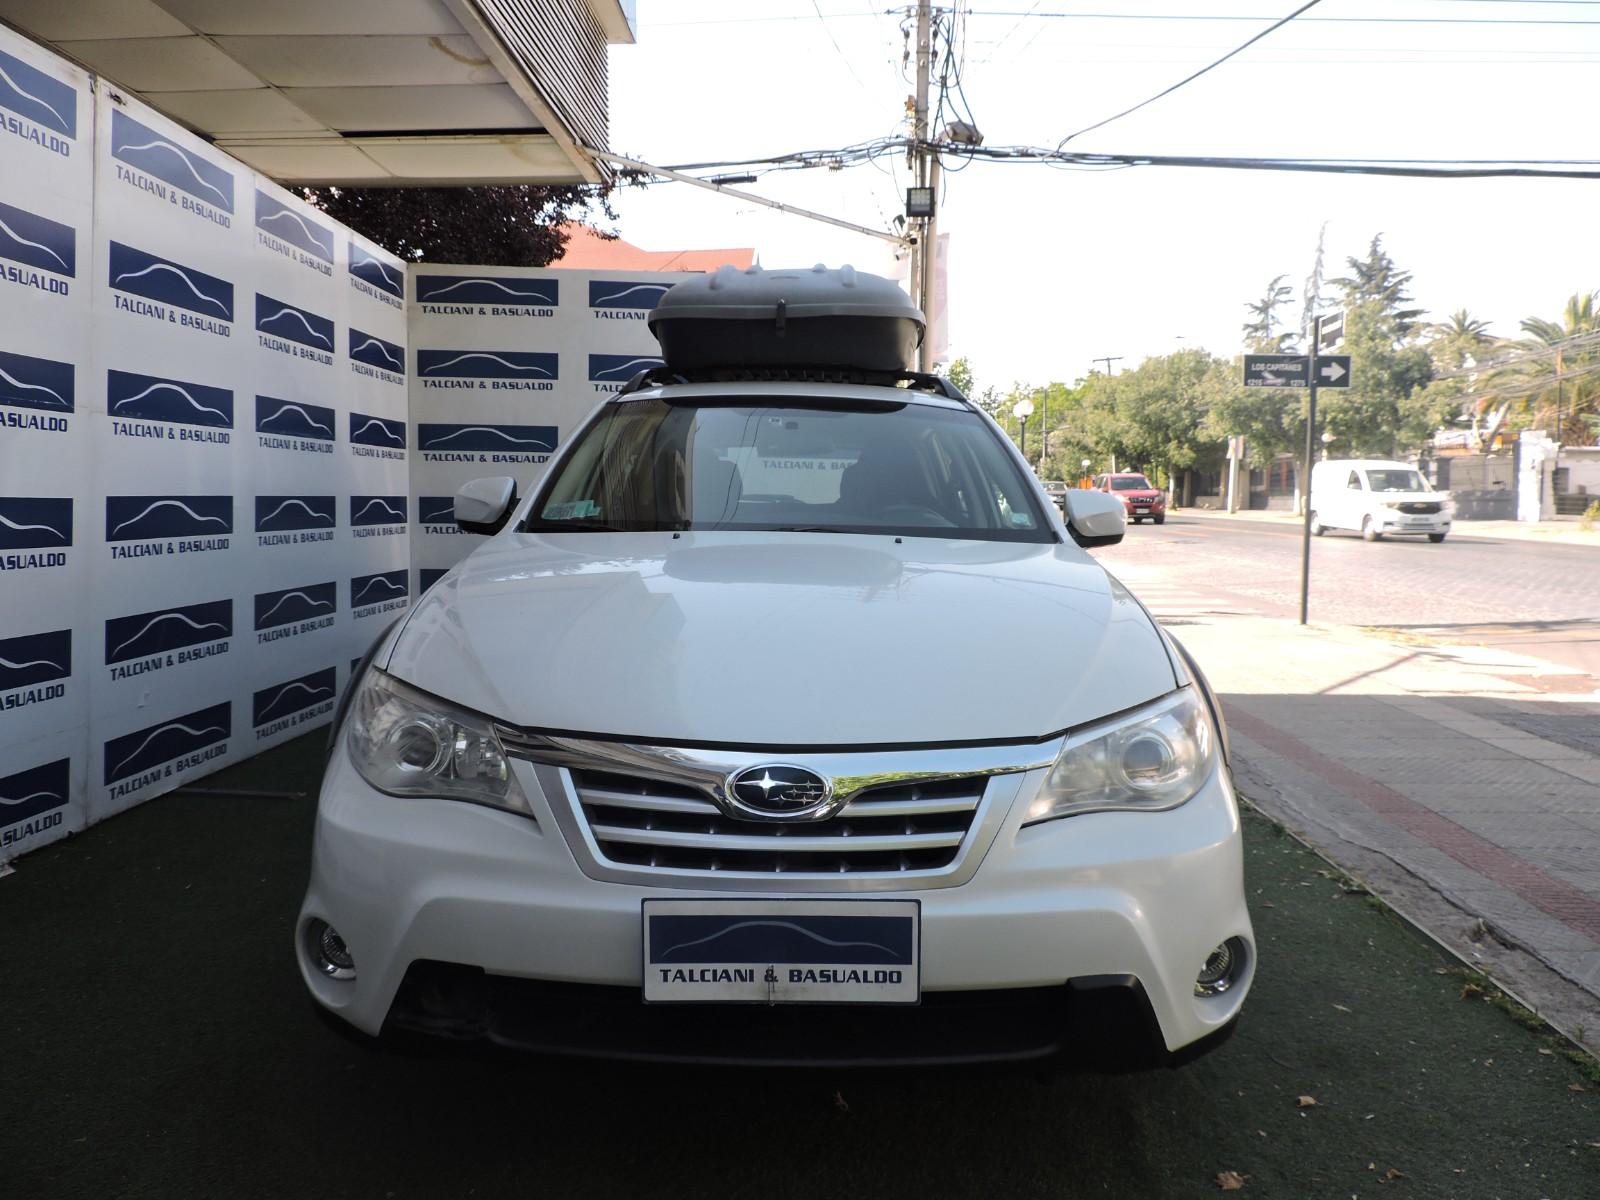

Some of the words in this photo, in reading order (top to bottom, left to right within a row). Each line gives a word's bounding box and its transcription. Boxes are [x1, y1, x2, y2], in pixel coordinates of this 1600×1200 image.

[116, 165, 166, 199] TALCIANI
[170, 191, 177, 205] &
[182, 196, 231, 229] BASUALDO
[259, 233, 290, 257] TALCIANI
[292, 249, 297, 261] &
[300, 251, 332, 277] BASUALDO
[351, 278, 372, 295] TALCIANI
[379, 290, 402, 310] BASUALDO
[114, 295, 165, 321] TALCIANI
[169, 310, 176, 322] &
[181, 314, 230, 338] BASUALDO
[422, 305, 474, 315] TALCIANI
[479, 306, 486, 315] &
[492, 307, 553, 317] BASUALDO
[594, 311, 645, 320] TALCIANI
[259, 336, 291, 355] TALCIANI
[293, 346, 298, 356] &
[300, 348, 333, 365] BASUALDO
[352, 363, 373, 377] TALCIANI
[381, 371, 403, 385] BASUALDO
[1251, 363, 1265, 371] LOS
[424, 379, 475, 389] TALCIANI
[479, 380, 486, 389] &
[492, 381, 552, 390] BASUALDO
[594, 384, 625, 392] TALC
[112, 423, 164, 438] TALCIANI
[168, 428, 175, 439] &
[180, 429, 230, 444] BASUALDO
[259, 437, 291, 449] TALCIANI
[294, 441, 298, 450] &
[301, 441, 333, 453] BASUALDO
[352, 447, 374, 457] TALCIANI
[381, 450, 404, 460] BASUALDO
[424, 454, 474, 462] TALCIANI
[480, 455, 487, 463] &
[259, 534, 291, 546] TALCIANI
[293, 534, 297, 543] &
[301, 531, 334, 543] BASUALDO
[352, 528, 374, 538] TALCIANI
[382, 526, 406, 536] BASUALDO
[424, 526, 474, 534] TALCIA
[111, 542, 164, 559] TALCIANI
[167, 543, 174, 554] &
[179, 539, 229, 553] BASUALDO
[258, 629, 291, 644] TALCIANI
[293, 626, 298, 635] &
[300, 617, 334, 634] BASUALDO
[110, 658, 163, 680] TALCIANI
[166, 655, 174, 667] &
[178, 642, 229, 663] BASUALDO
[256, 719, 289, 740] TALCIANI
[300, 702, 333, 722] BASUALDO
[109, 770, 162, 800] TALCIANI
[165, 765, 173, 777] &
[177, 743, 228, 773] BASUALDO
[0, 812, 63, 848] SUALDO
[660, 969, 754, 982] TALCIANI
[764, 969, 778, 982] &
[789, 970, 901, 984] BASUALDO
